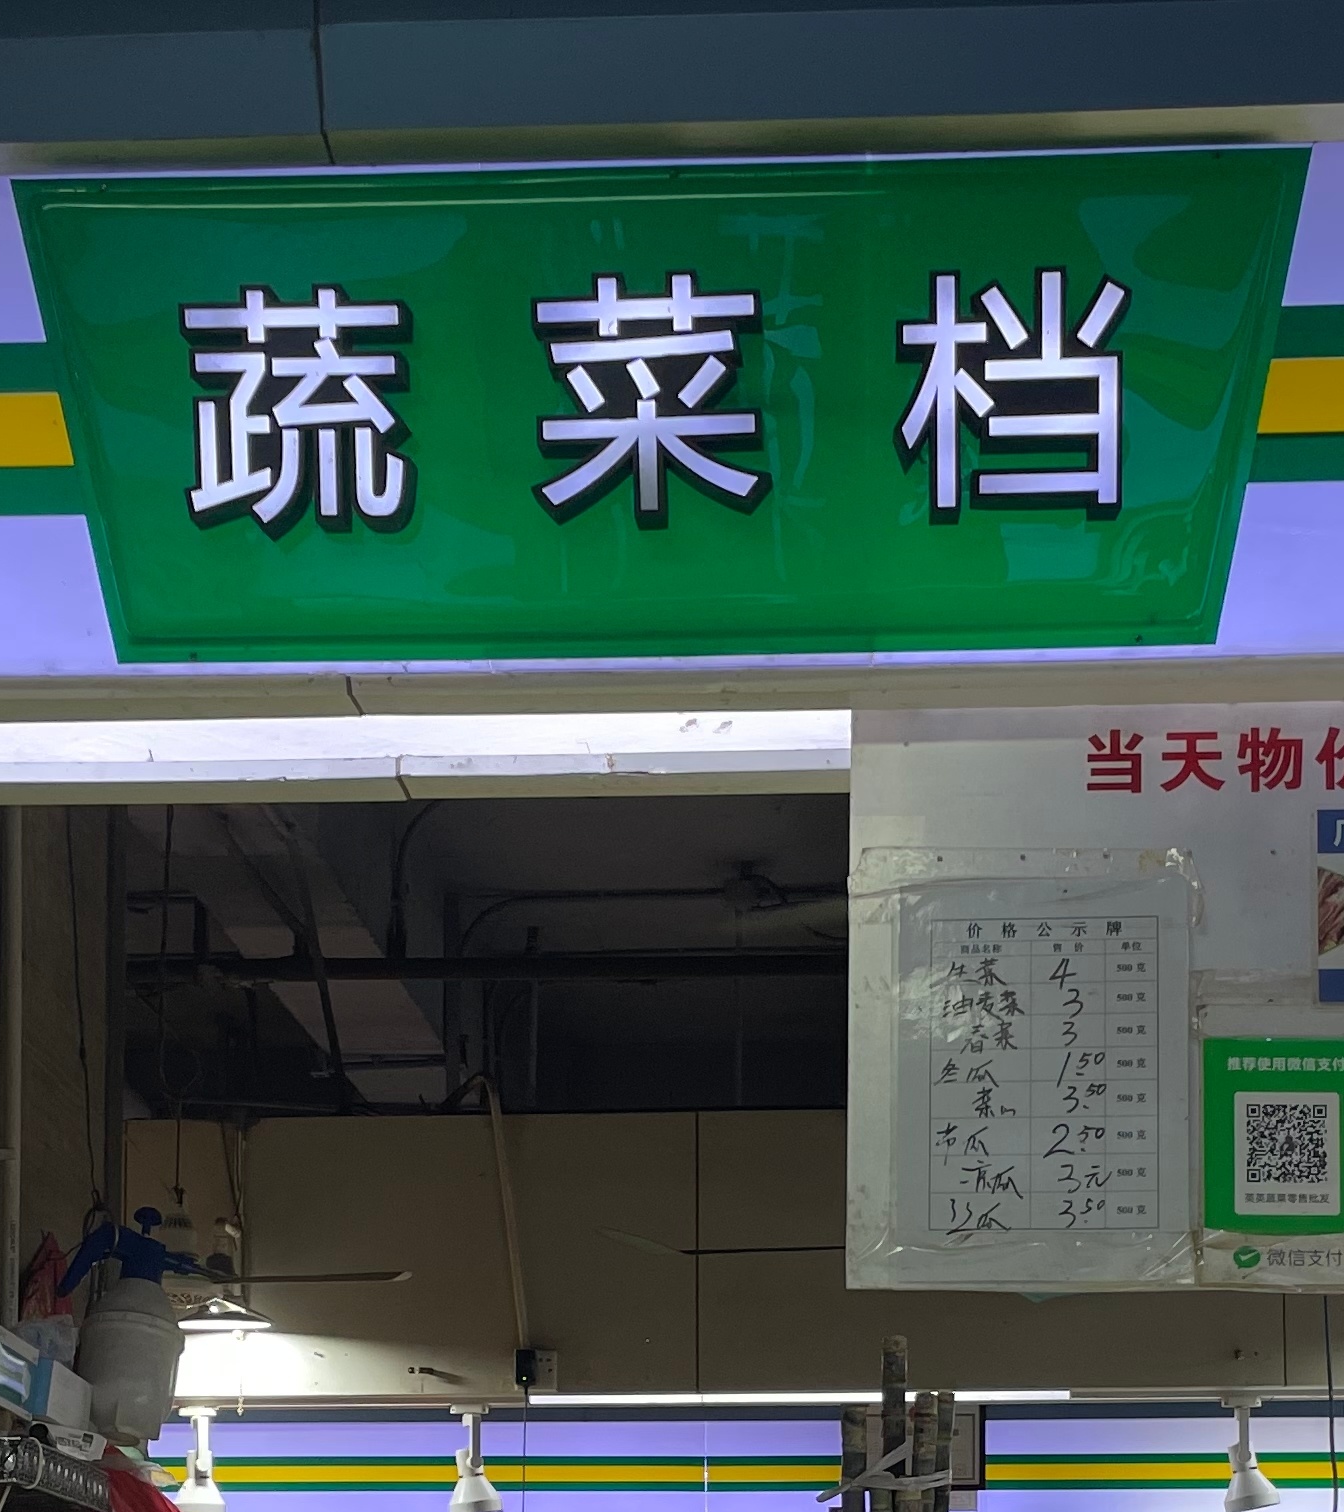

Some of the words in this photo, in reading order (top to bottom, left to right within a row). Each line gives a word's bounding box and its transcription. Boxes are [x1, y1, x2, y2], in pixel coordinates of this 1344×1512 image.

[180, 270, 1127, 524] 蔬菜档
[966, 920, 1123, 937] 价格公示牌
[1266, 1248, 1343, 1268] 微信支付
